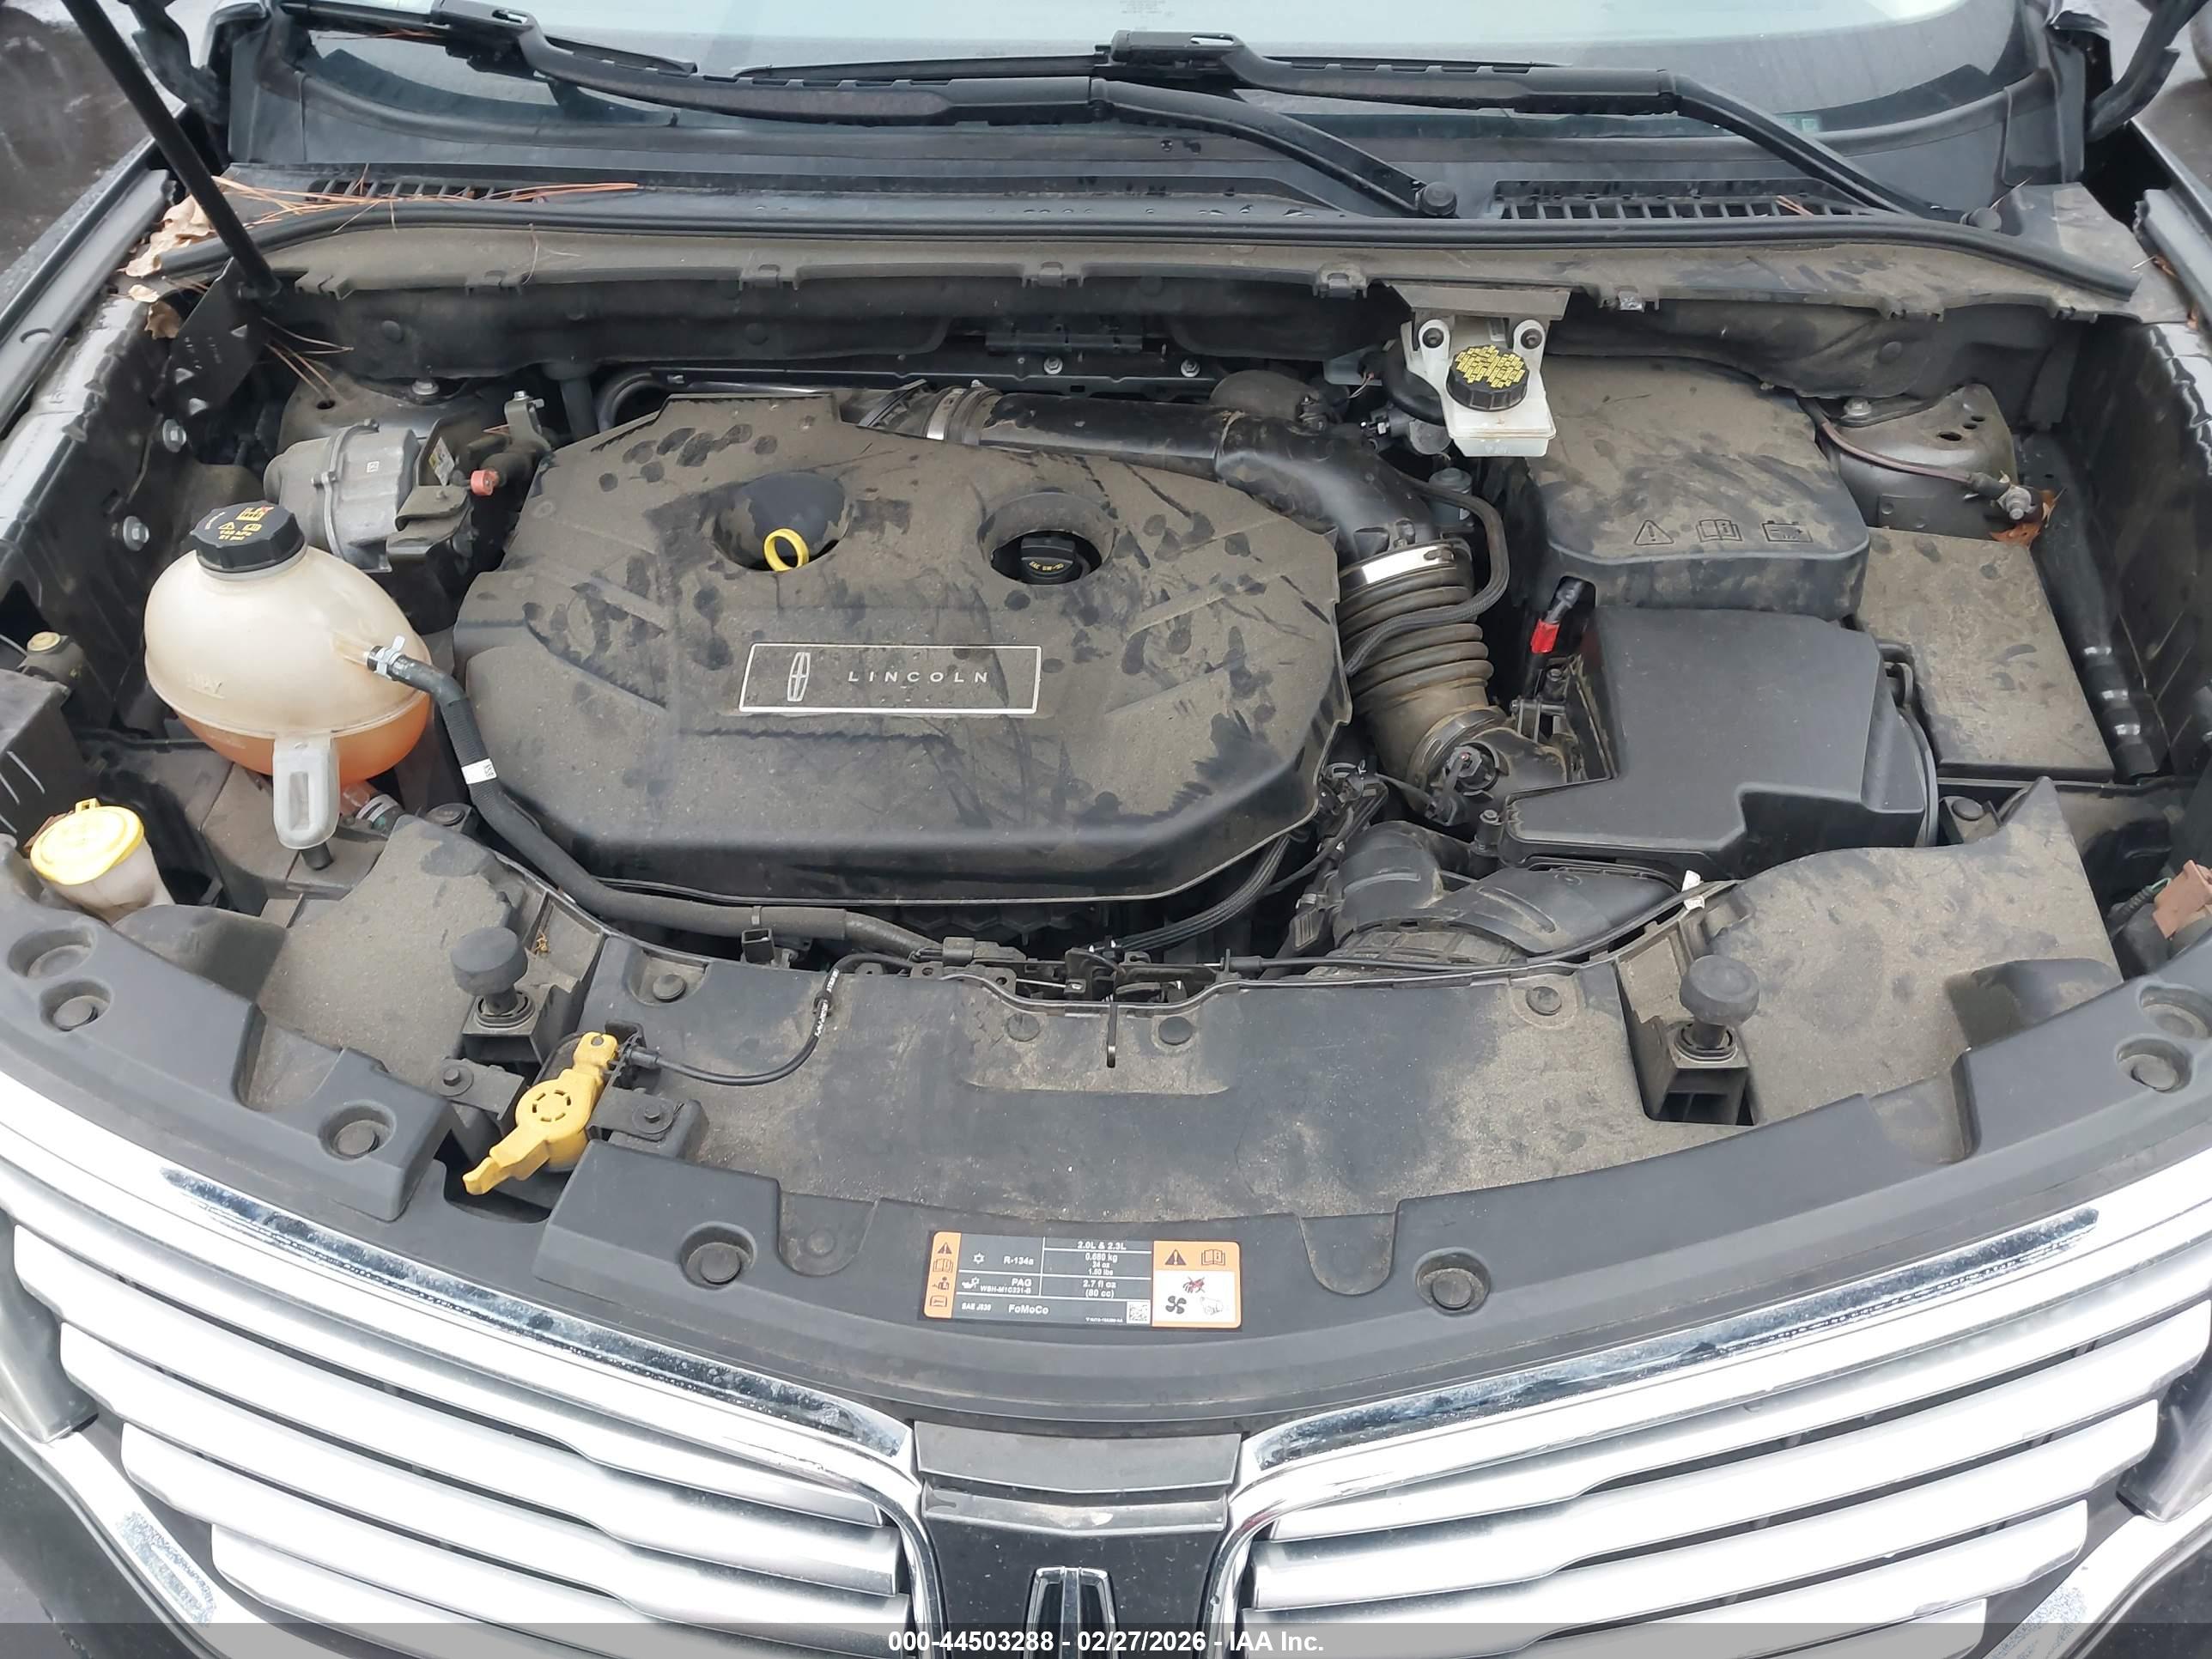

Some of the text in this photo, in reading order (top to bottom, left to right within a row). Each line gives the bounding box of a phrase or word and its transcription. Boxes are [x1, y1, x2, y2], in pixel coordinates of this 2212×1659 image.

[848, 671, 988, 683] LINCOLN
[1078, 1240, 1096, 1249] 2.0L
[1108, 1242, 1126, 1250] 2.3L
[1003, 1256, 1034, 1265] R-134a
[1108, 1253, 1118, 1263] kg
[1012, 1278, 1032, 1287] PAG
[1083, 1280, 1097, 1288] 2.7
[1085, 1289, 1114, 1298] (80 cc)
[1009, 1304, 1049, 1315] FoMoCo
